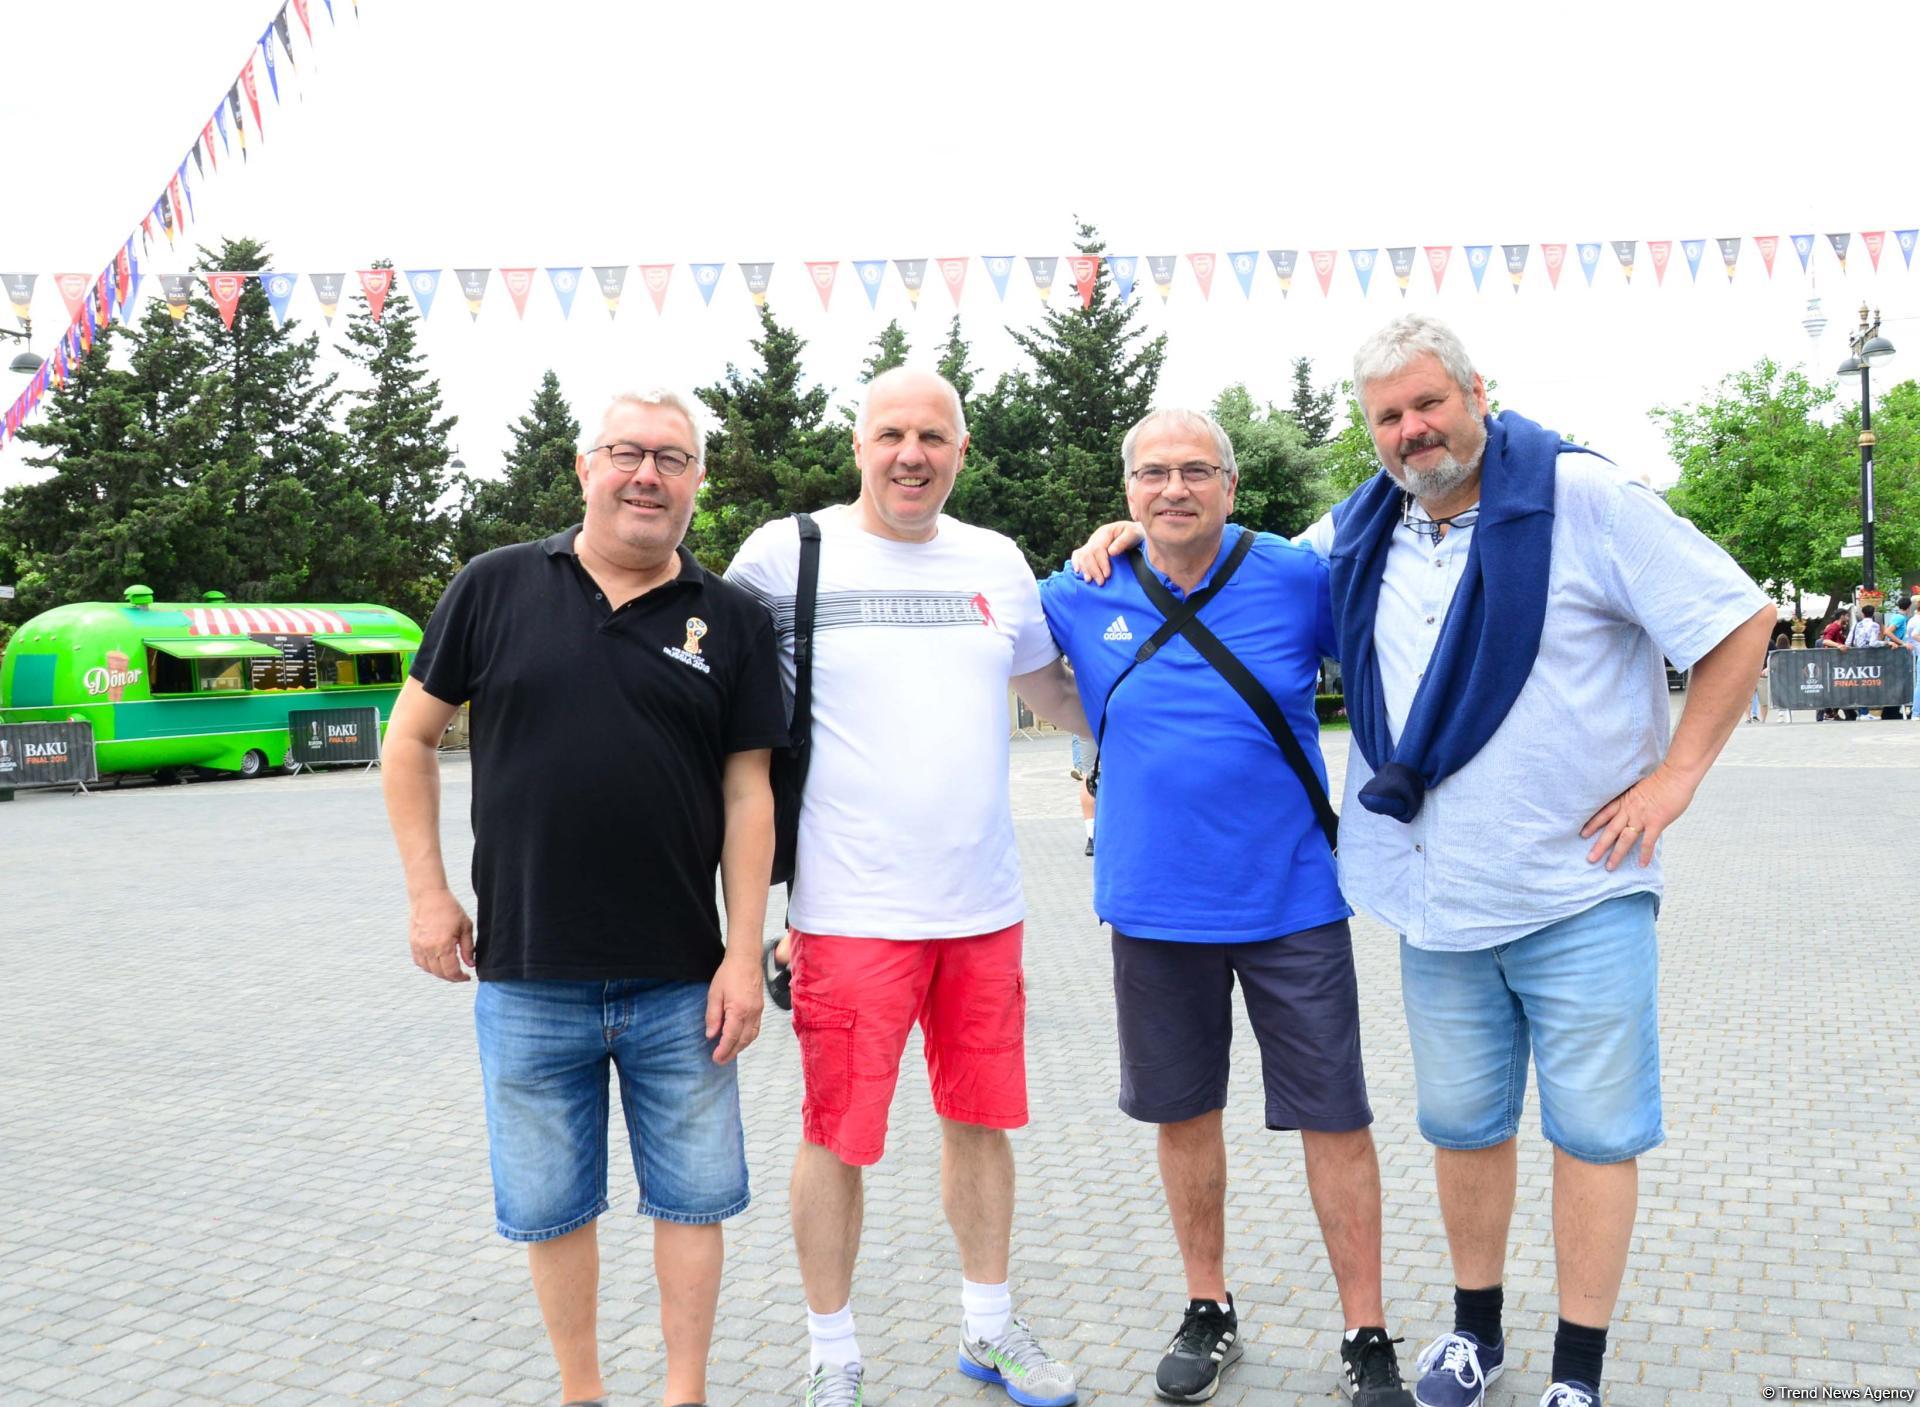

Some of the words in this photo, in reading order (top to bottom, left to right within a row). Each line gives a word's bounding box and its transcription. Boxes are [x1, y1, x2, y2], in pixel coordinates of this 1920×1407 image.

[1103, 631, 1133, 641] adidas
[1832, 666, 1882, 680] BAKU
[328, 724, 358, 736] BAKU
[24, 742, 68, 756] BAKU
[26, 756, 49, 764] FINAL
[50, 755, 68, 763] 2019
